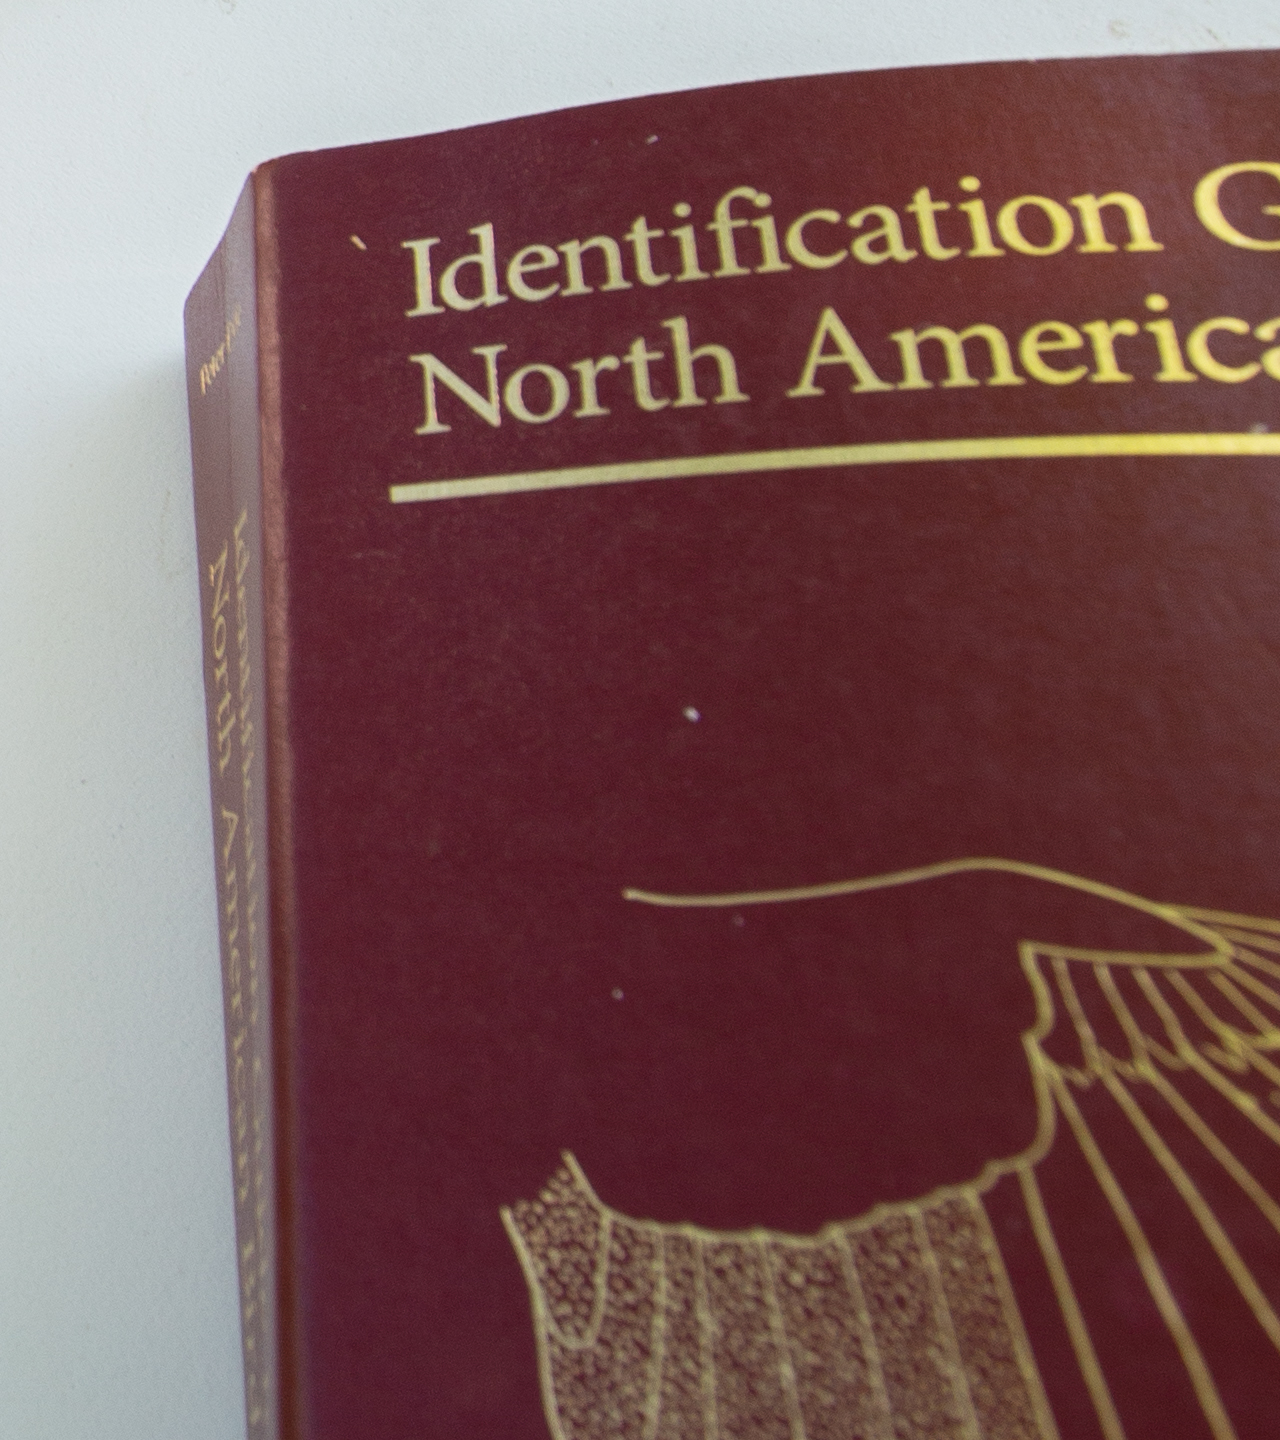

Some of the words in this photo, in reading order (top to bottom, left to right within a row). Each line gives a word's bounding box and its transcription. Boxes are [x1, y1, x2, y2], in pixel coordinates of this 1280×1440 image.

[402, 177, 1164, 317] Identification
[410, 317, 750, 434] North
[209, 541, 237, 777] North
